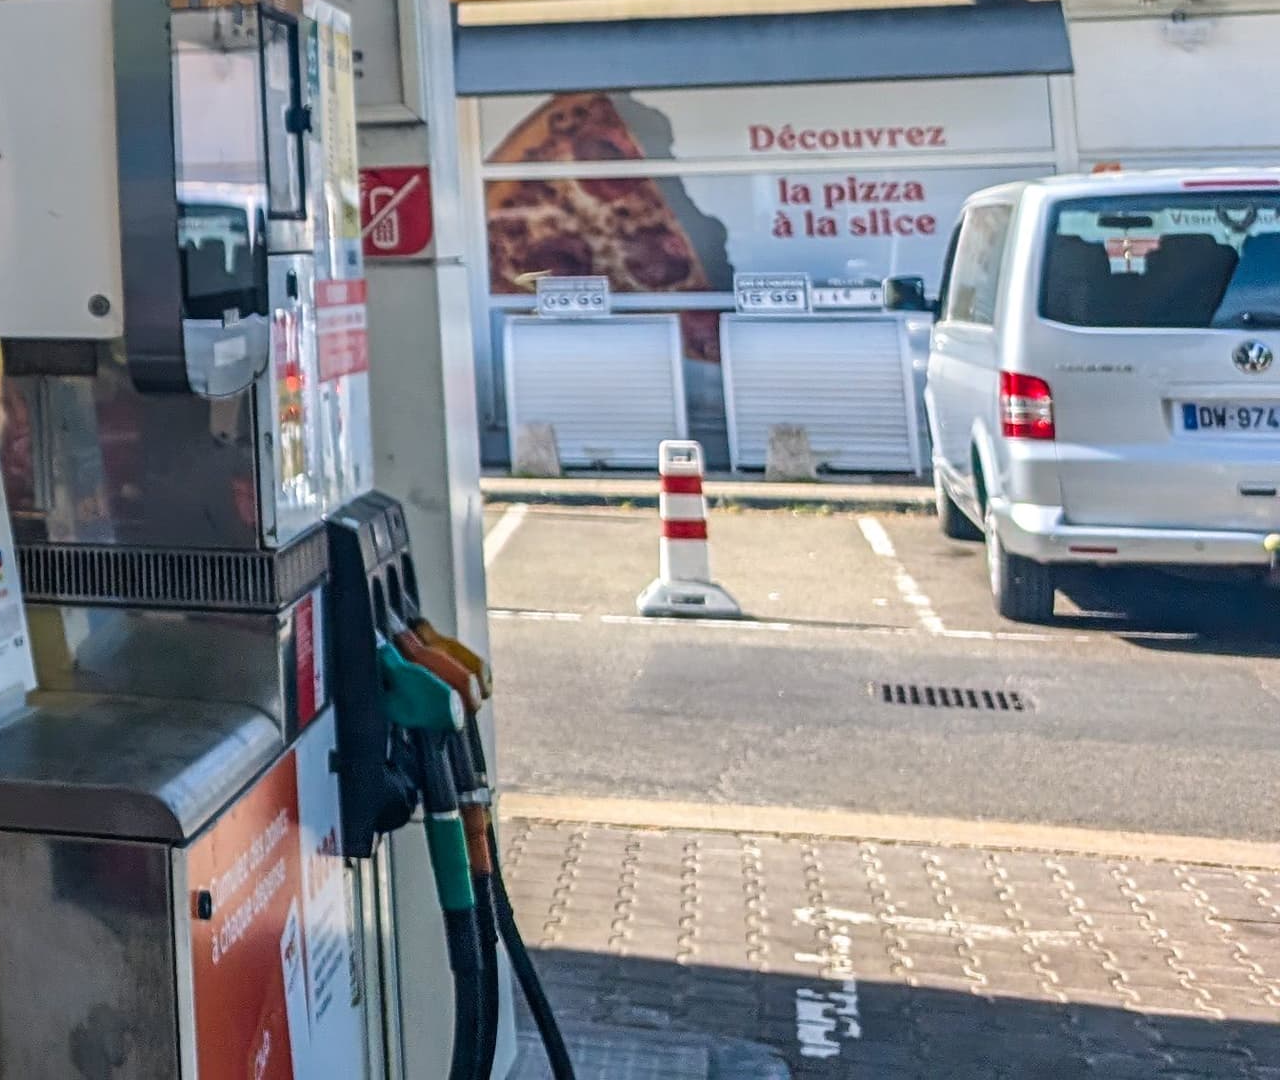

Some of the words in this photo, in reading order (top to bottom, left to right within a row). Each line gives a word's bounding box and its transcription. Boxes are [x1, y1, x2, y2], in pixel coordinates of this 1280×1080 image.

[748, 123, 948, 151] Découvrez
[778, 177, 812, 204] la
[822, 175, 925, 209] pizza
[772, 210, 794, 238] à
[804, 210, 838, 238] la
[848, 207, 937, 237] slice
